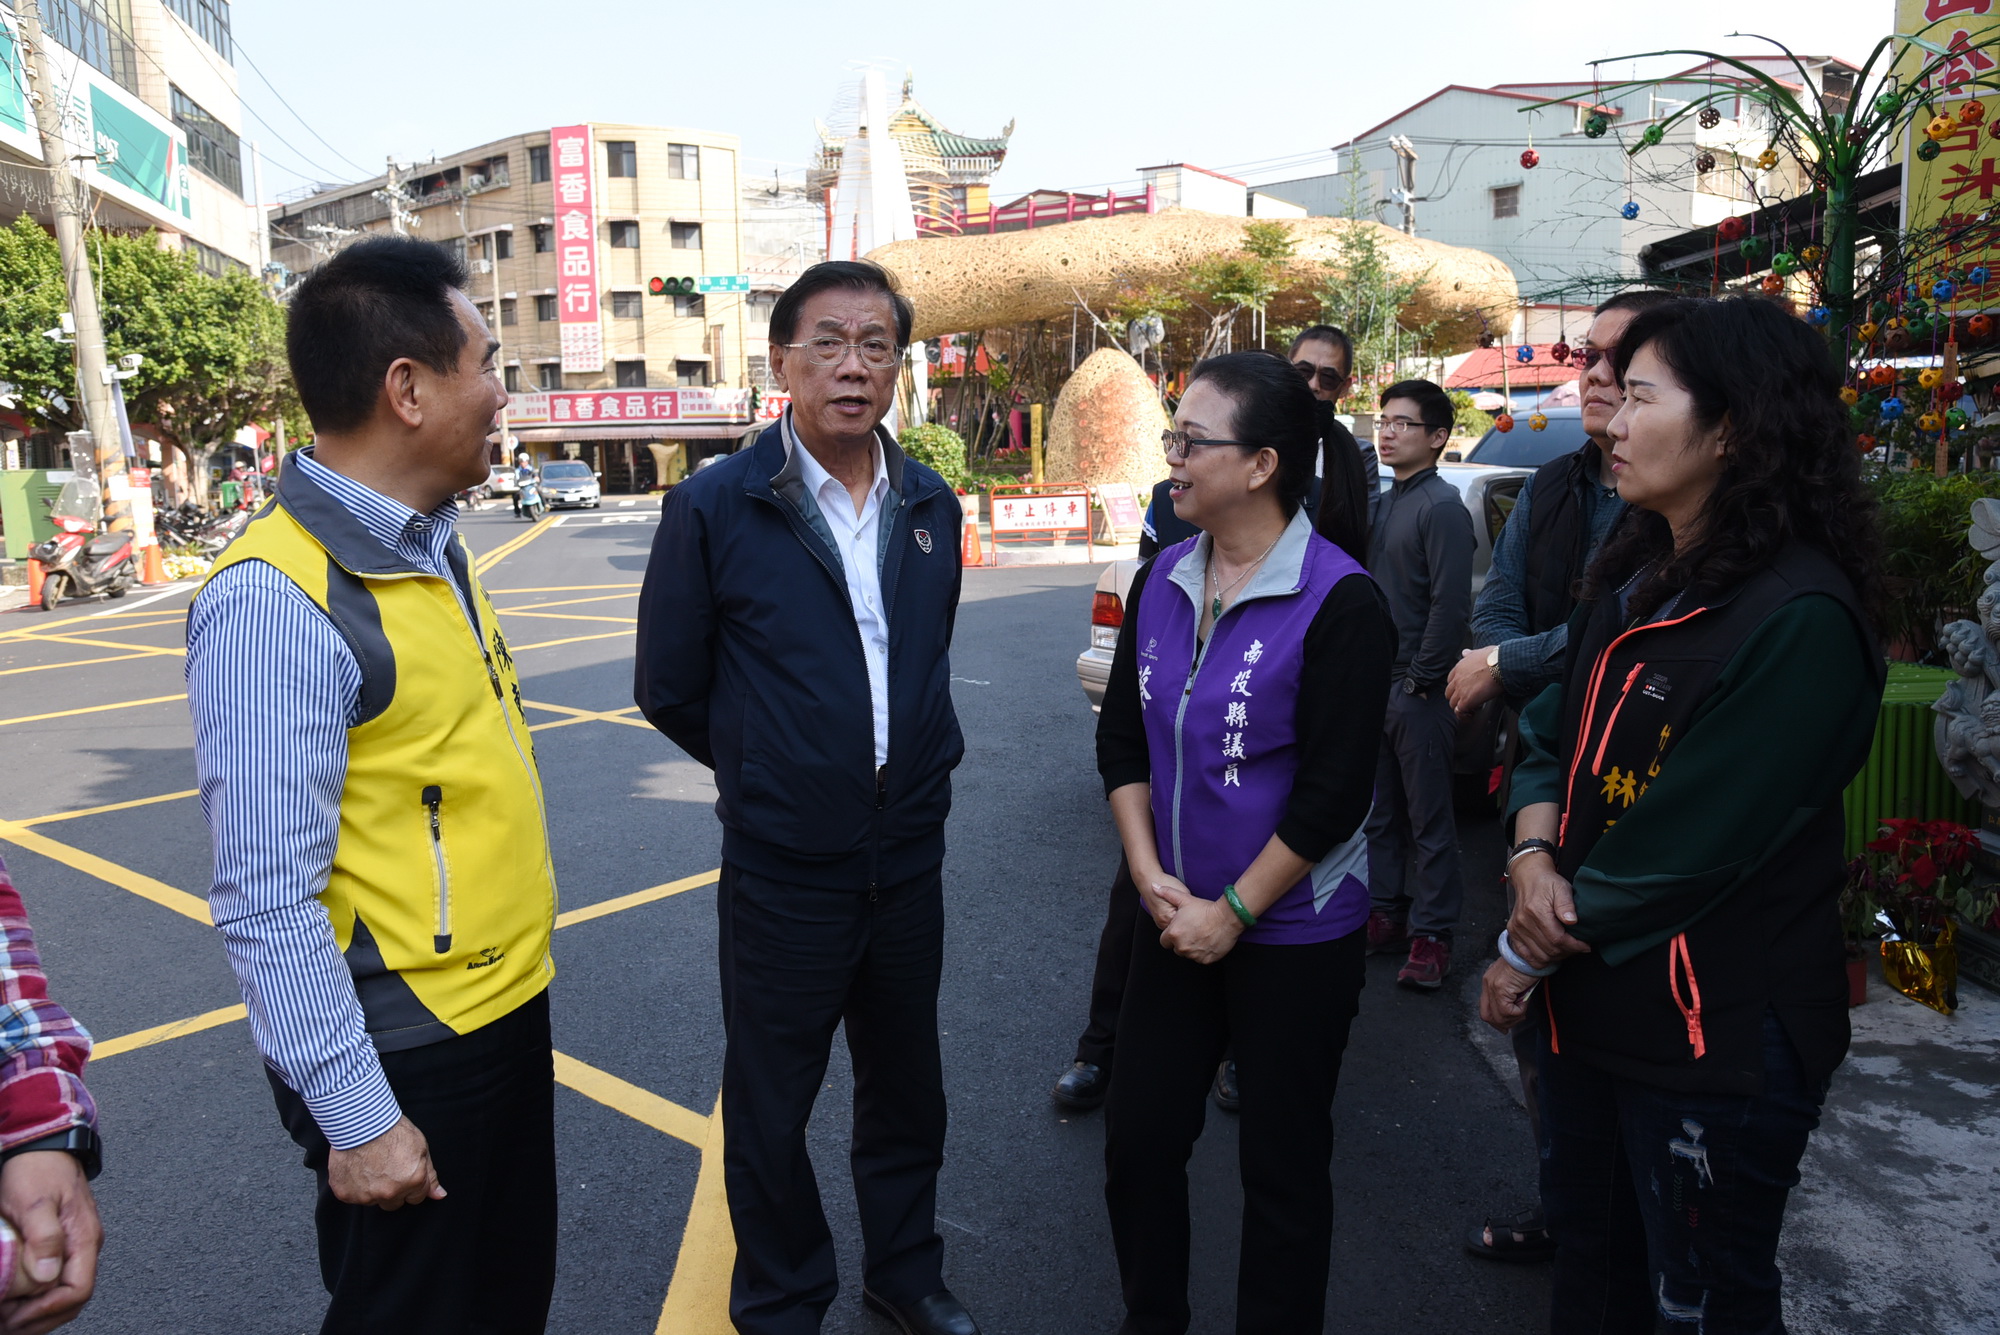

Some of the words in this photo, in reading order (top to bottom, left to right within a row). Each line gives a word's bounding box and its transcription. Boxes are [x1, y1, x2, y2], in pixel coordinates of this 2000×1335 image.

[557, 136, 592, 313] 富香食品行
[553, 395, 673, 419] 富香食品行
[1003, 501, 1078, 519] 禁止停車
[1221, 638, 1264, 788] 南投縣議員
